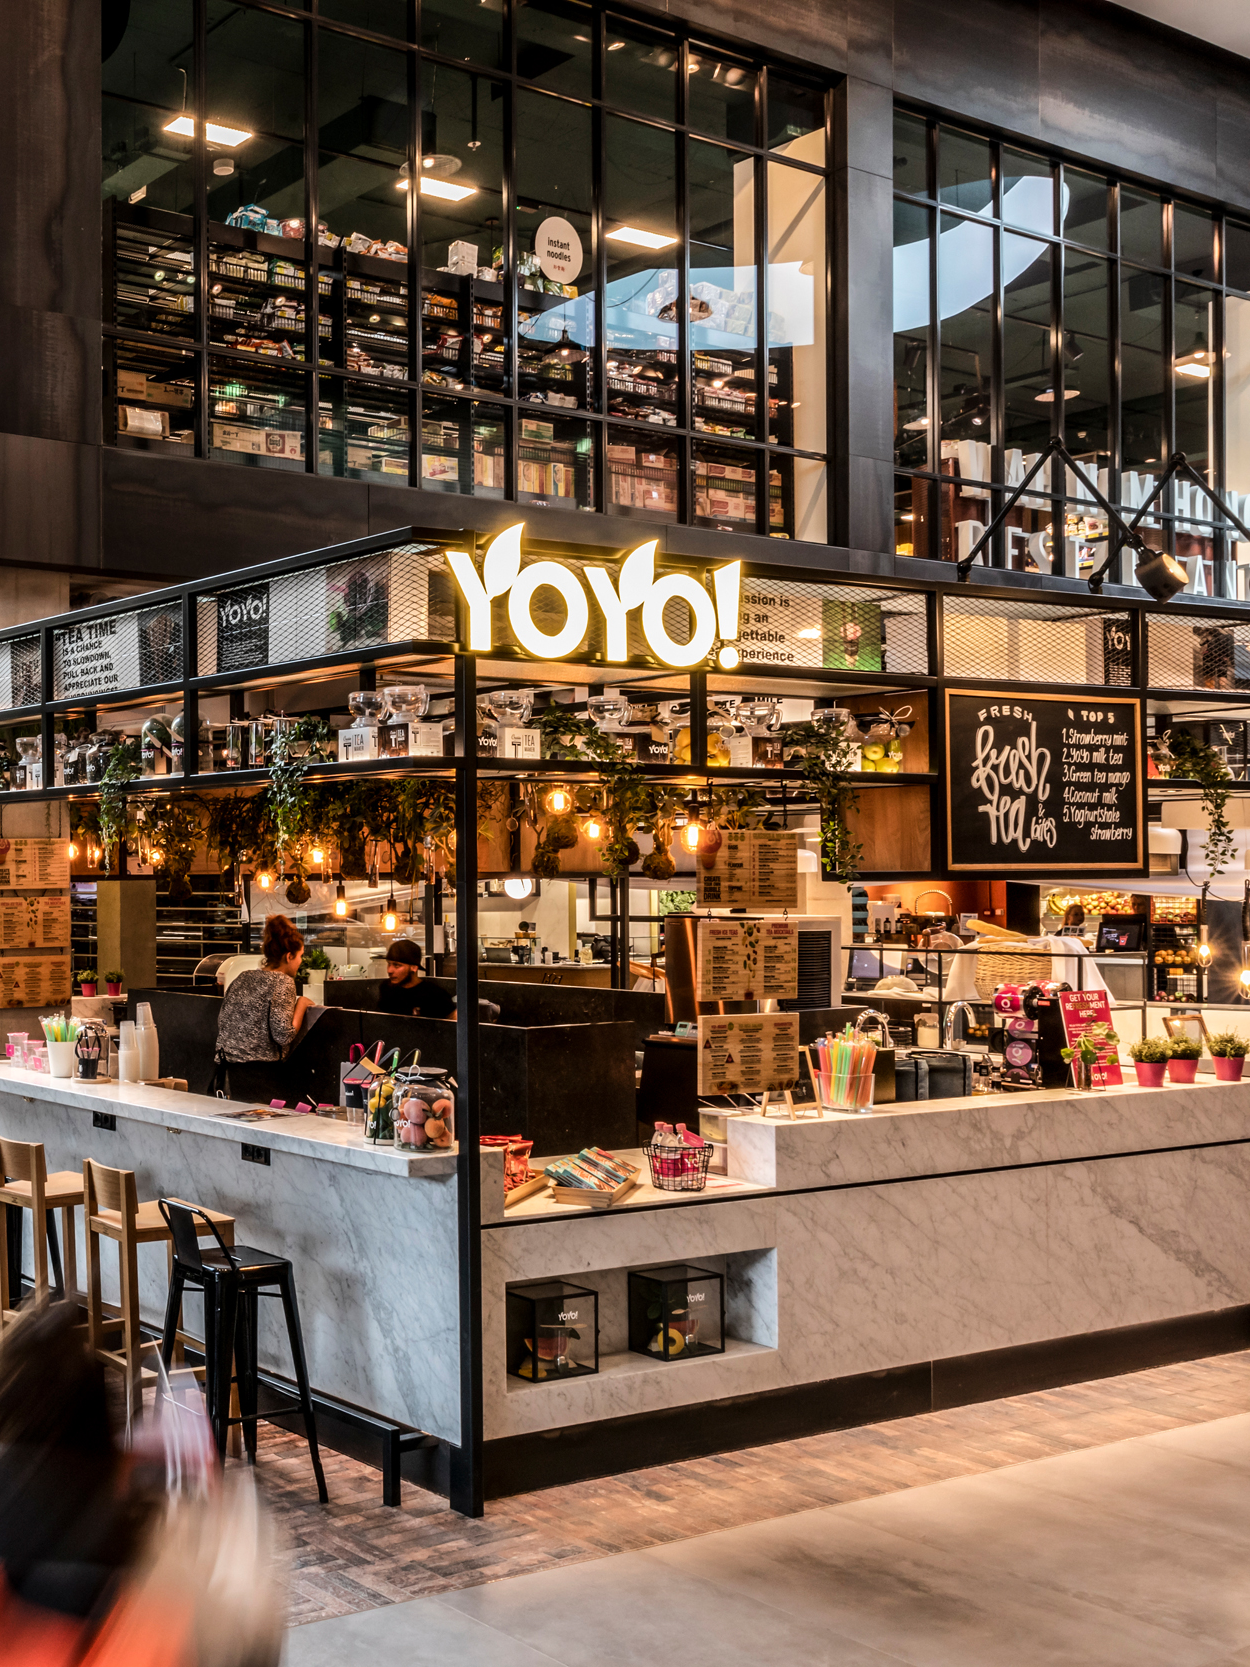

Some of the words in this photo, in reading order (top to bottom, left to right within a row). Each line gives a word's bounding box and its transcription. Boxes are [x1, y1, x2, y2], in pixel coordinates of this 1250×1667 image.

[547, 250, 571, 262] noodles
[445, 522, 741, 668] YOYO!
[779, 595, 790, 607] is
[220, 593, 268, 628] YOYO!
[754, 613, 769, 623] an
[87, 619, 117, 639] TIME
[76, 640, 103, 654] CHANCE
[63, 671, 79, 680] PULL
[81, 666, 98, 677] BACK
[100, 662, 114, 673] AND
[64, 676, 103, 692] APPRECIATE
[104, 674, 119, 685] OUR
[978, 705, 1032, 722] FRESH
[1081, 710, 1104, 722] TOP
[1107, 712, 1115, 724] 5
[354, 733, 364, 746] TEA
[524, 735, 535, 747] TEA
[1113, 731, 1129, 746] mint
[1092, 747, 1107, 764] milk
[1109, 748, 1123, 765] tea
[1094, 768, 1107, 783] tea
[1108, 771, 1131, 790] mango
[1102, 787, 1118, 804] milk
[1038, 803, 1046, 817] &
[1031, 817, 1057, 848] bites
[1090, 824, 1133, 840] strawberry
[1069, 994, 1081, 1002] GET
[558, 1311, 579, 1321] YOYO!
